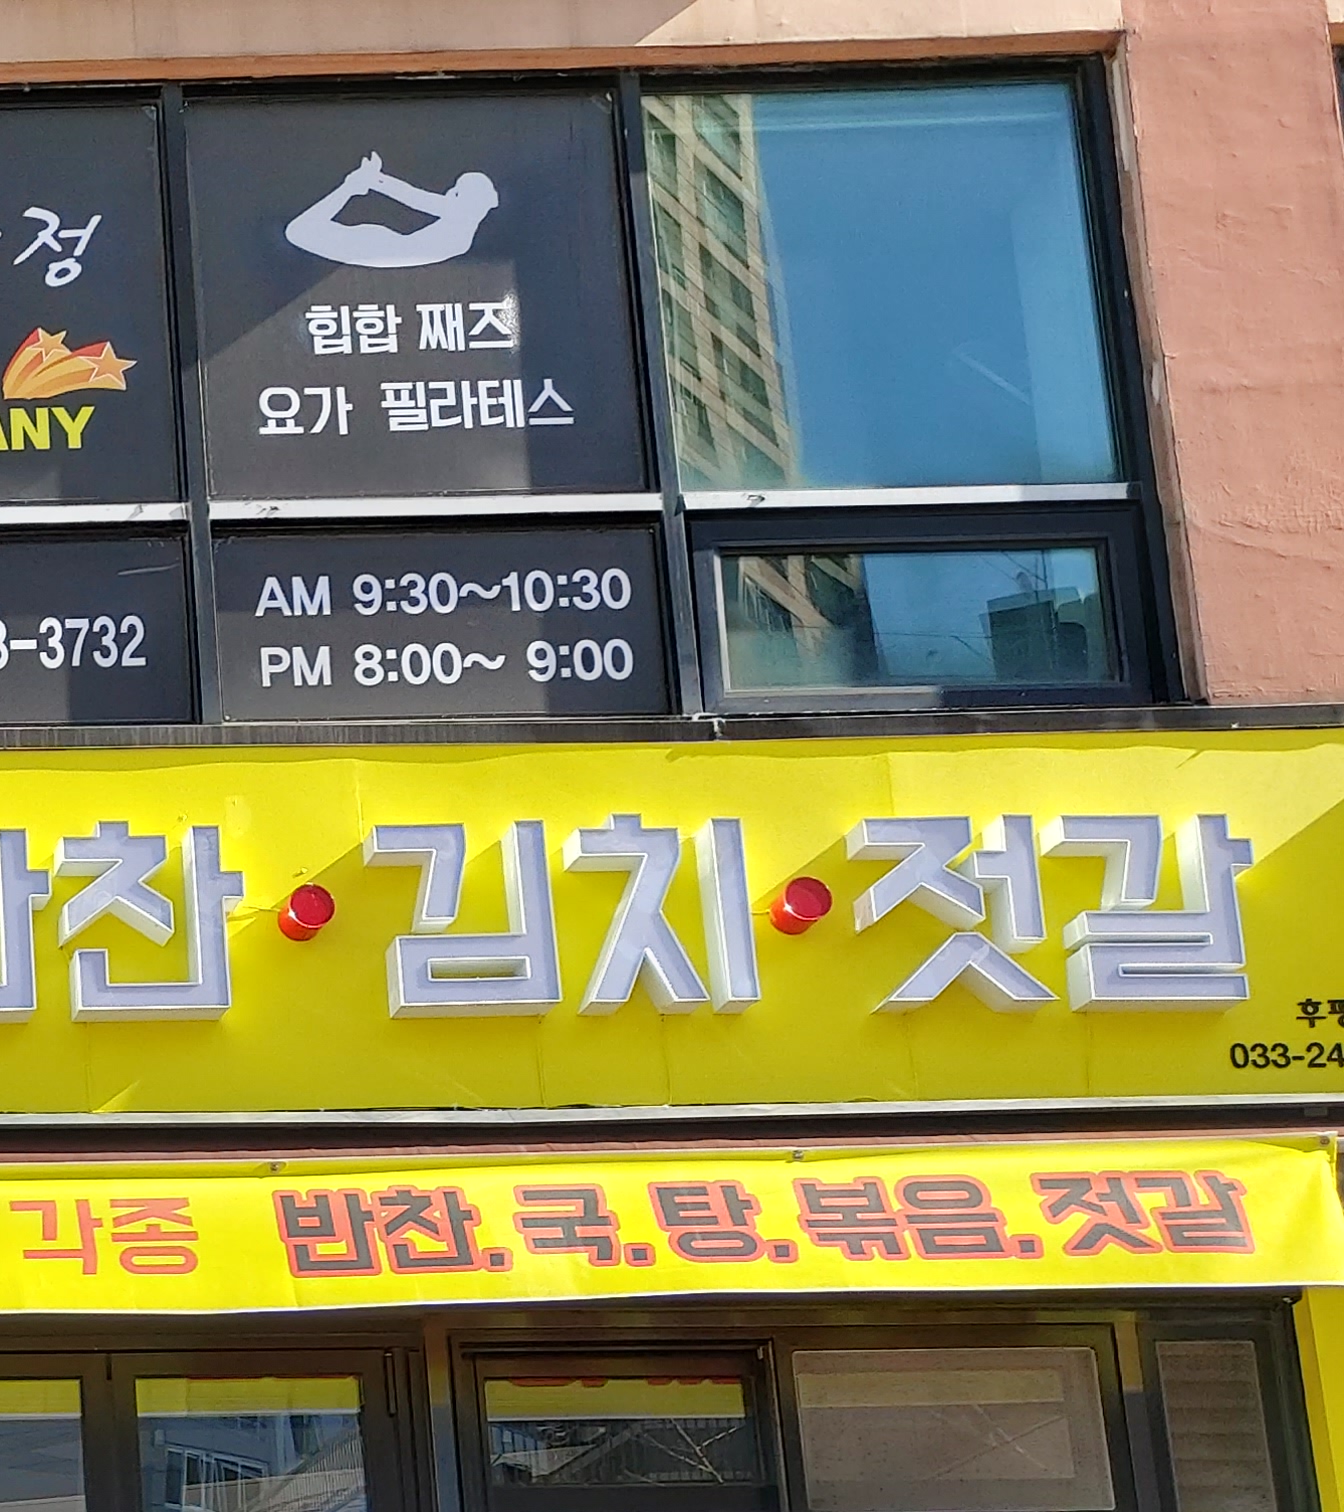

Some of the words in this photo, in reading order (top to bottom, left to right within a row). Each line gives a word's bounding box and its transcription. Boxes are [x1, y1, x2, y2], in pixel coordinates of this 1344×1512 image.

[306, 305, 401, 356] 힙합
[417, 303, 517, 352] 째즈
[258, 386, 352, 437] 요가
[381, 379, 575, 430] 필라테스
[255, 577, 330, 617] AM
[353, 569, 631, 615] 9:30~10:30
[261, 648, 332, 688] PM
[527, 638, 634, 681] 9:00
[10, 1196, 199, 1276] 각종
